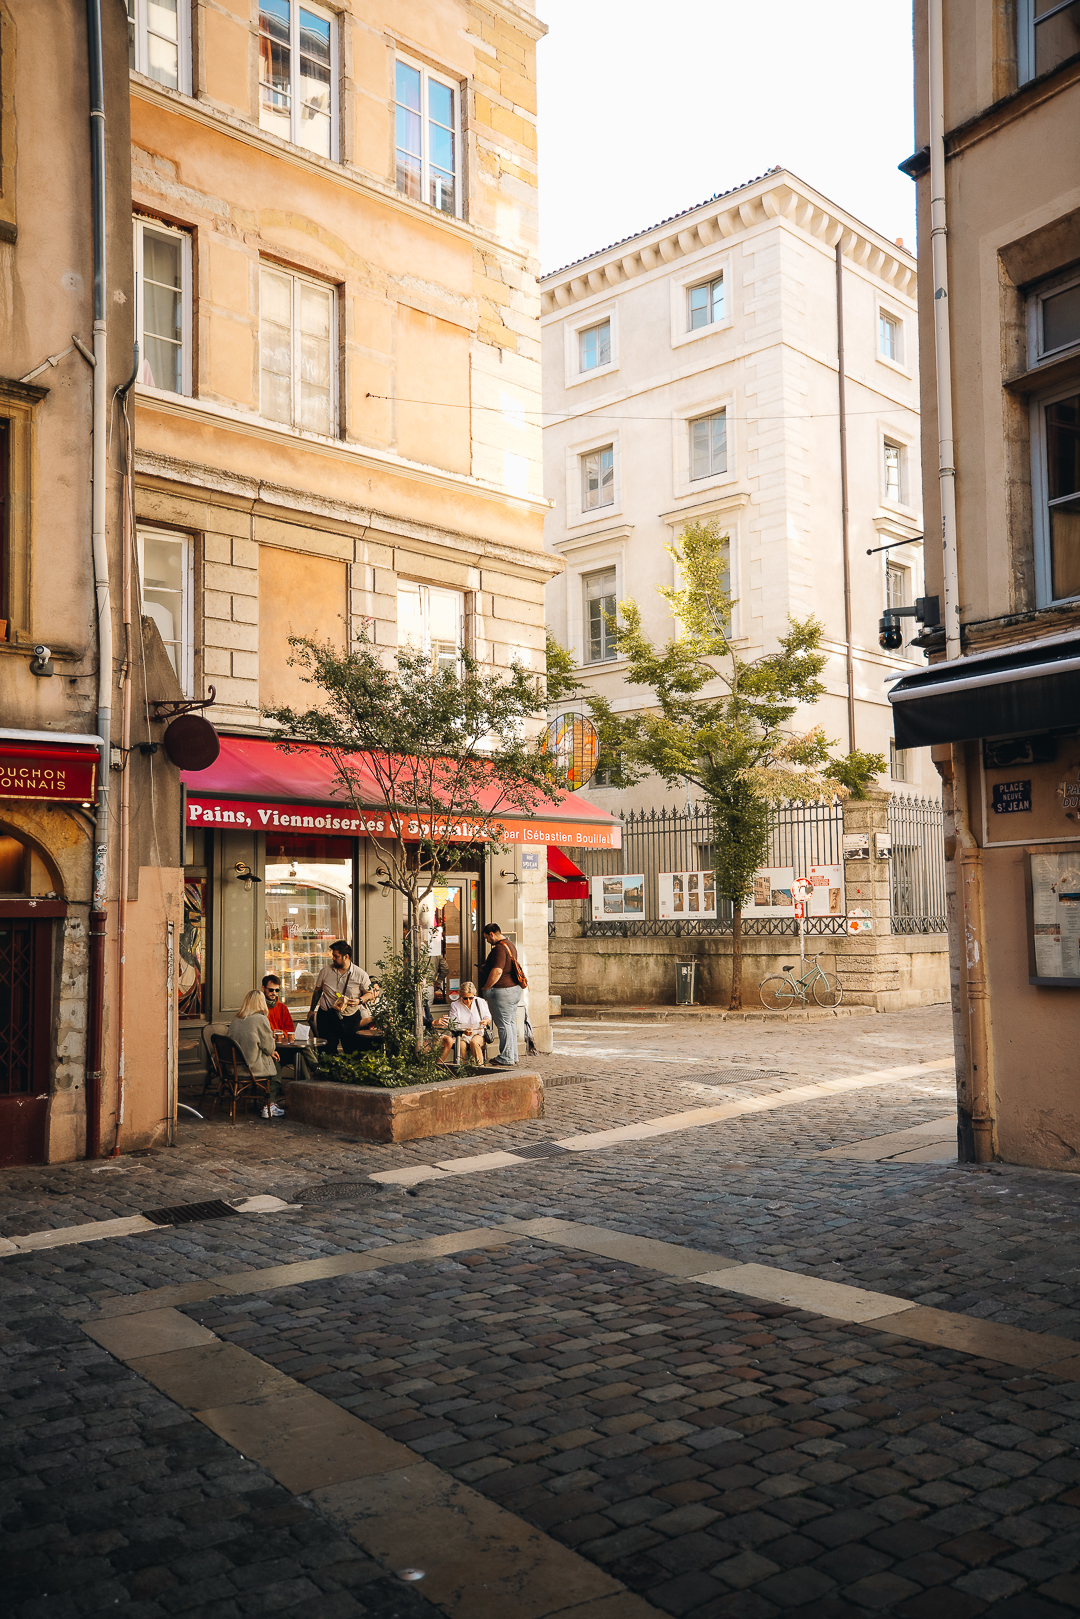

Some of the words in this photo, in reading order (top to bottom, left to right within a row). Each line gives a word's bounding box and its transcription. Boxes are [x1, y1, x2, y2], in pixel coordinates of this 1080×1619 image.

[1, 778, 66, 791] ONNAIS
[999, 782, 1024, 793] PLACE
[1002, 792, 1022, 801] NEUVE
[1008, 800, 1030, 811] JEAN
[188, 805, 252, 827] Pains,
[257, 809, 385, 832] Viennoiseries
[503, 831, 520, 840] par
